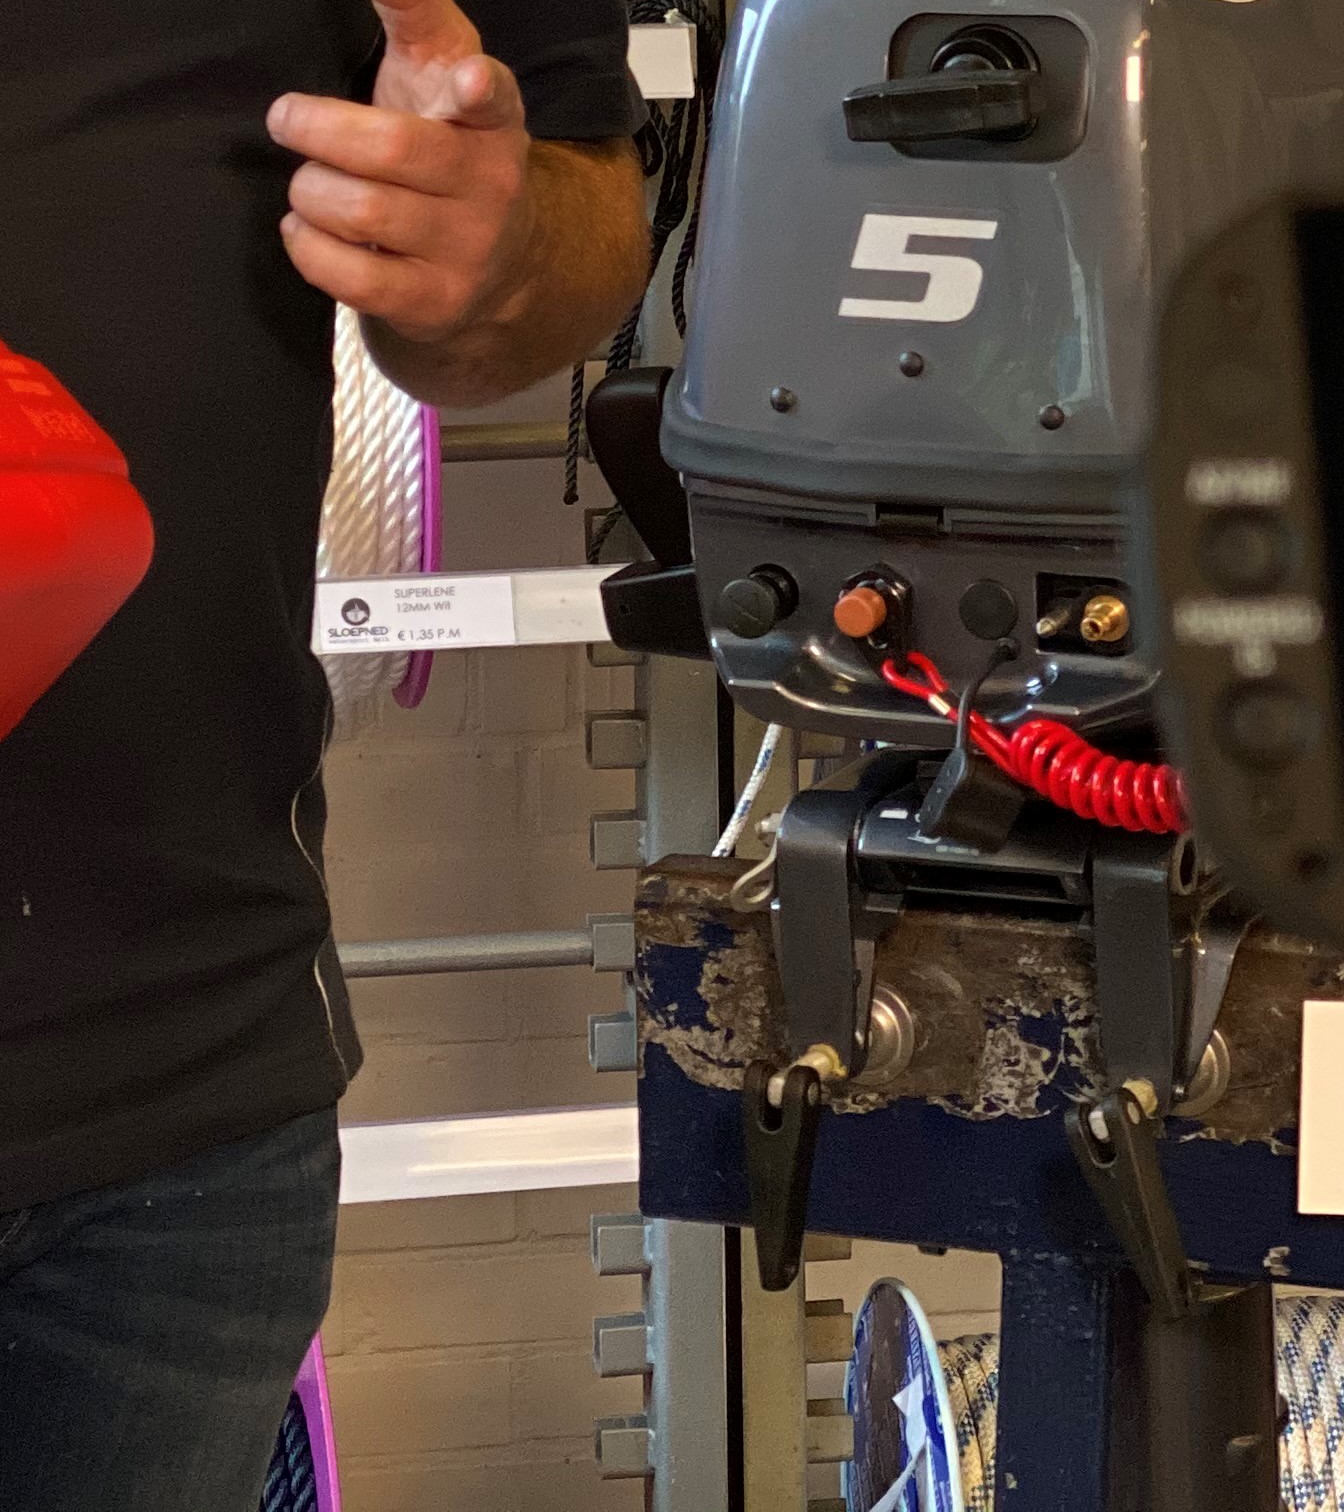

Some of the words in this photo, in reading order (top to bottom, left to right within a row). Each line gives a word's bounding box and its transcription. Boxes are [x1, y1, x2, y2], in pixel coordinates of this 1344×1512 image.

[837, 212, 999, 323] 5
[394, 586, 456, 599] SUPERLENE
[396, 602, 431, 613] 12MM
[327, 626, 389, 638] SLOEPNED
